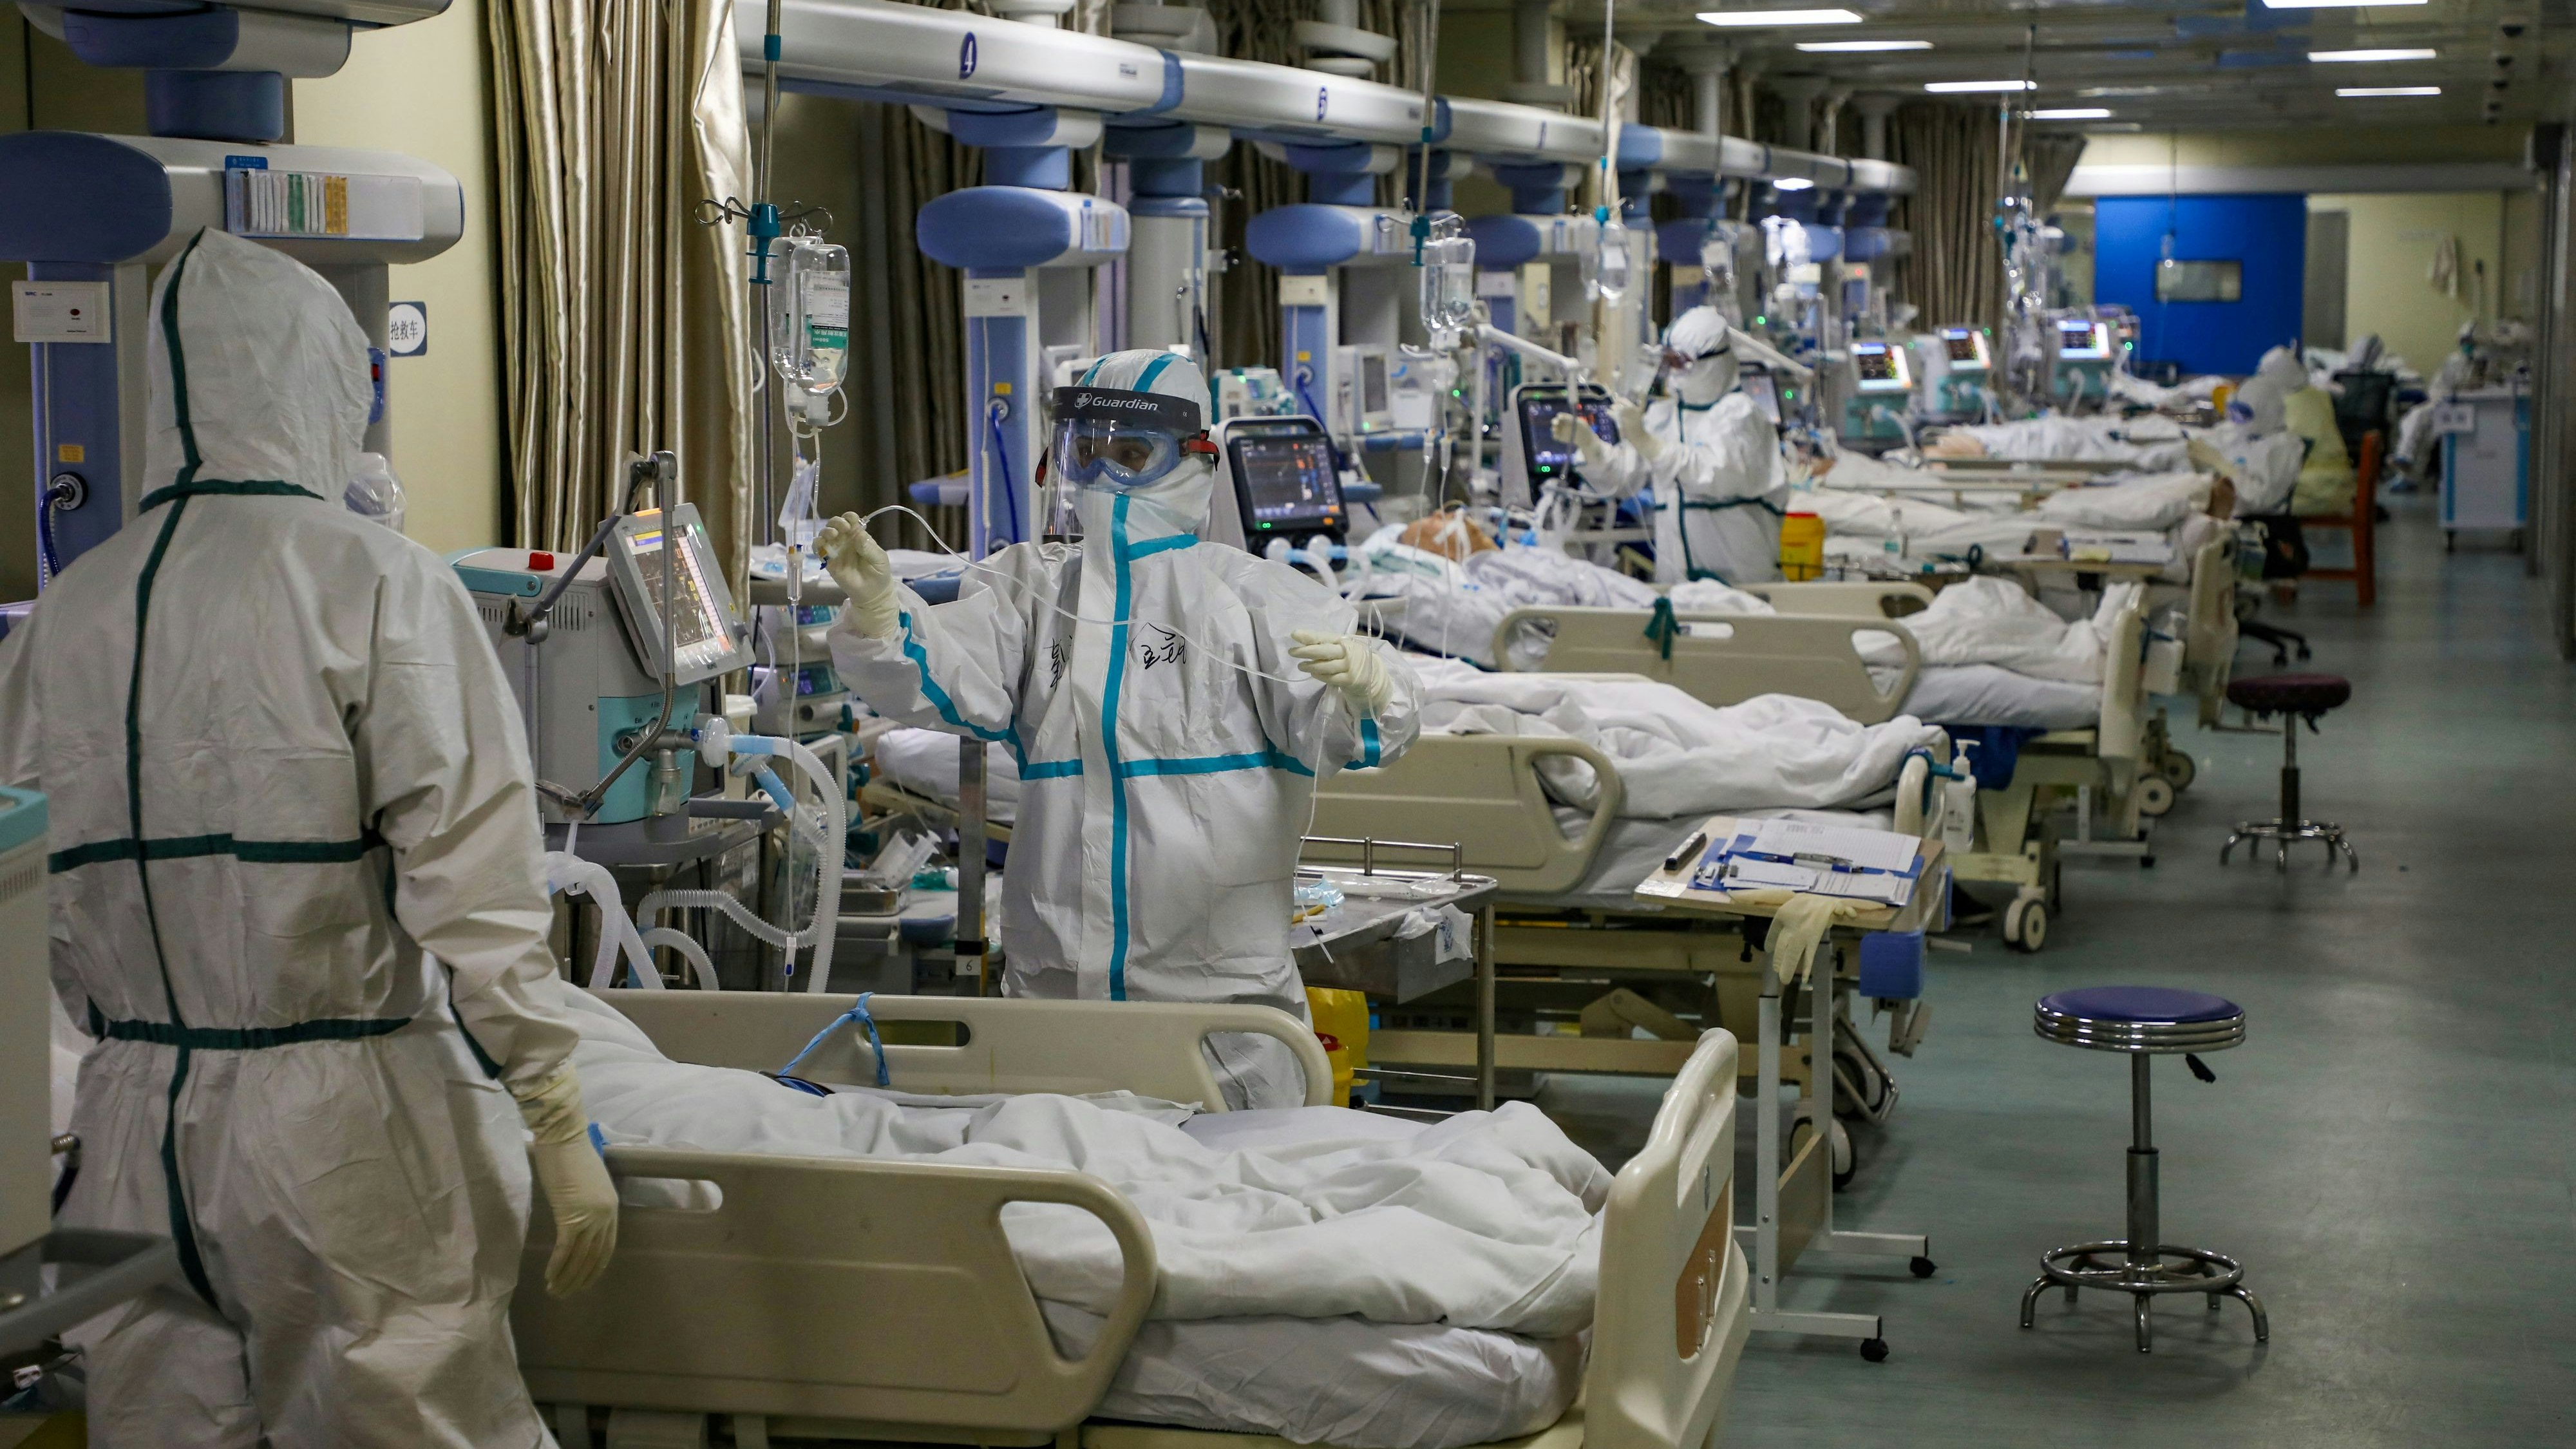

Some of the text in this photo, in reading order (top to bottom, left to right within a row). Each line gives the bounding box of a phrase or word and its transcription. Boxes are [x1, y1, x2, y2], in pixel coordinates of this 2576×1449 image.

[964, 40, 974, 73] 4
[390, 319, 418, 340] 抢救车
[1092, 397, 1159, 412] Guardian
[966, 959, 973, 972] 6
